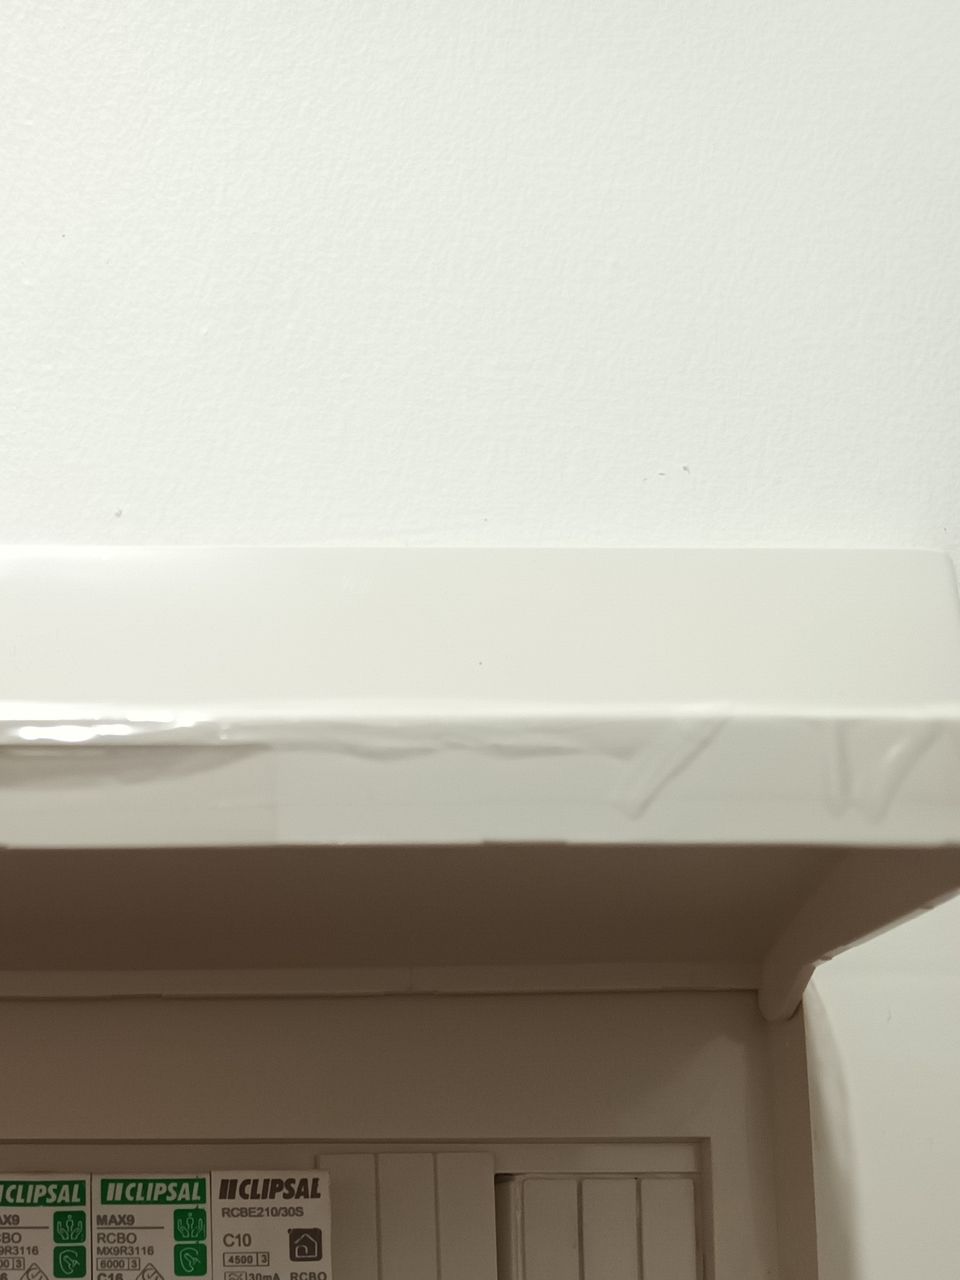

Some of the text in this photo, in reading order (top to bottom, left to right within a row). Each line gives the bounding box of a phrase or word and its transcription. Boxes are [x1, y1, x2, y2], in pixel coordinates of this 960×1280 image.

[221, 1207, 304, 1218] RCBE210/30S
[96, 1214, 135, 1226] MAX9
[97, 1232, 137, 1244] RCBO
[223, 1233, 252, 1247] C10
[96, 1246, 154, 1256] MX9R3116
[100, 1260, 125, 1269] 6000
[228, 1255, 253, 1264] 4500
